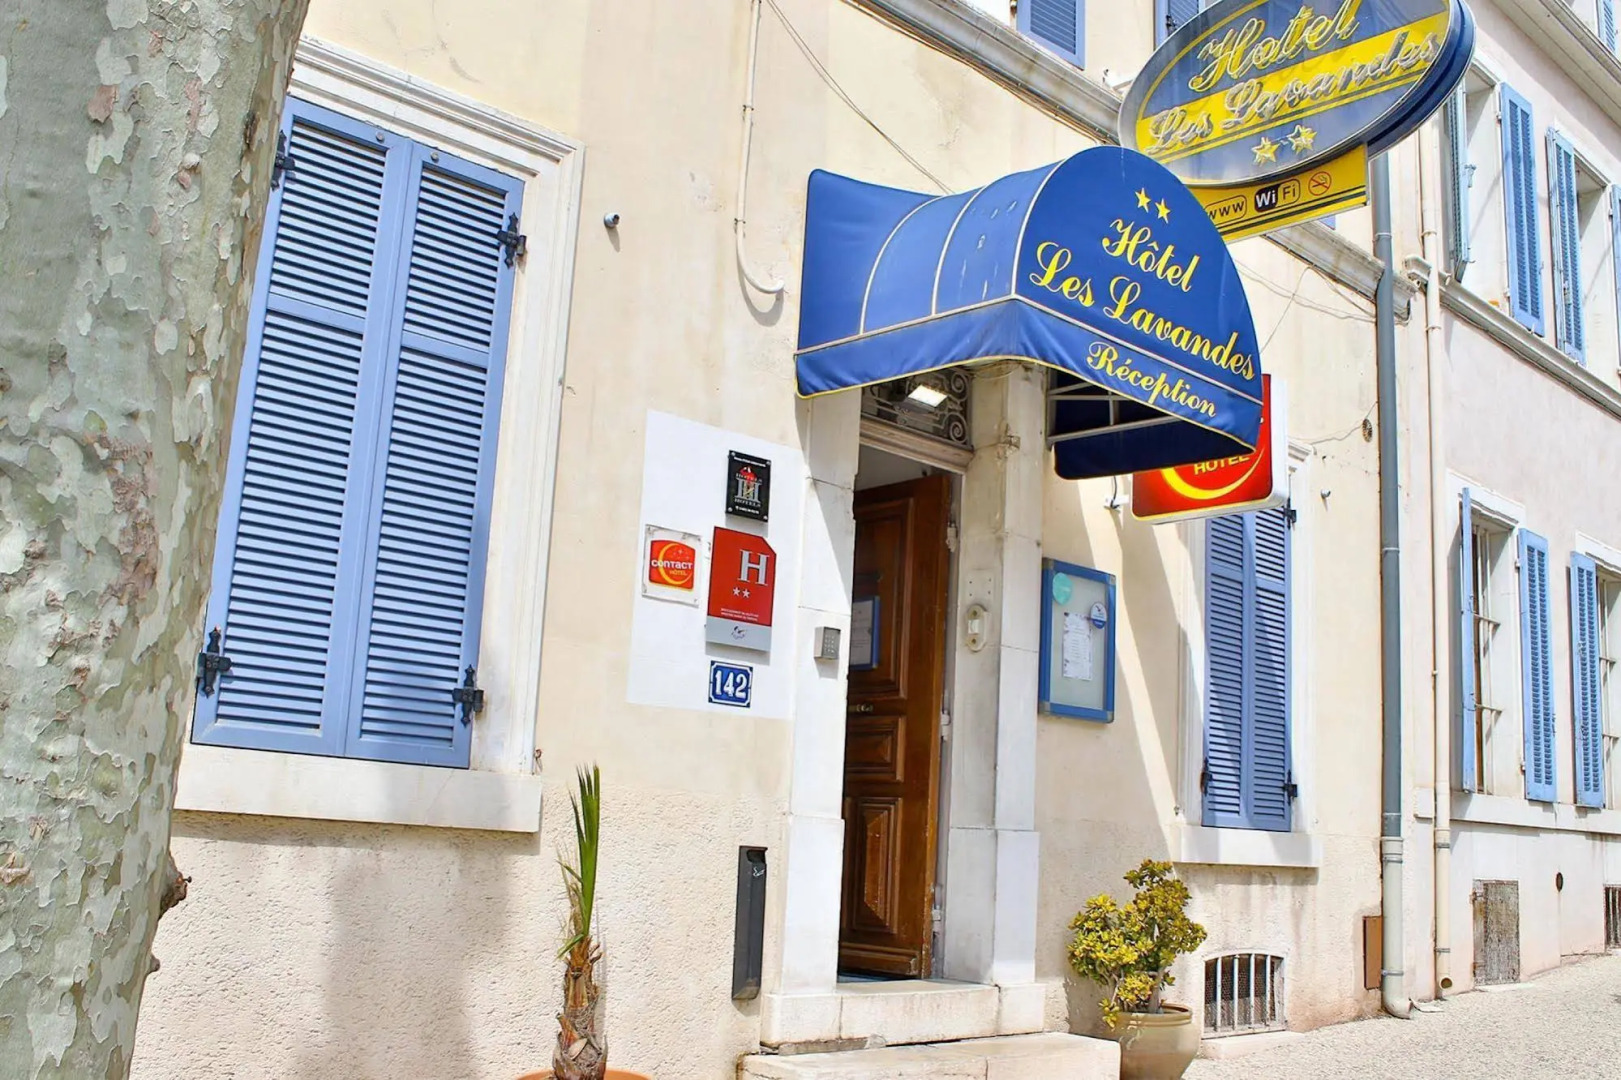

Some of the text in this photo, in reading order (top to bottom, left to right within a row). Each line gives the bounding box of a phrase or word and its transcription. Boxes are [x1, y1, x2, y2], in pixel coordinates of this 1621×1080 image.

[1188, 0, 1361, 92] Hotel
[1145, 30, 1442, 154] Les Lavandes
[1102, 217, 1200, 292] Hôtel
[1029, 241, 1256, 381] Les Lavandes
[1086, 341, 1217, 418] Réception
[737, 549, 769, 587] H
[714, 669, 748, 699] 142
